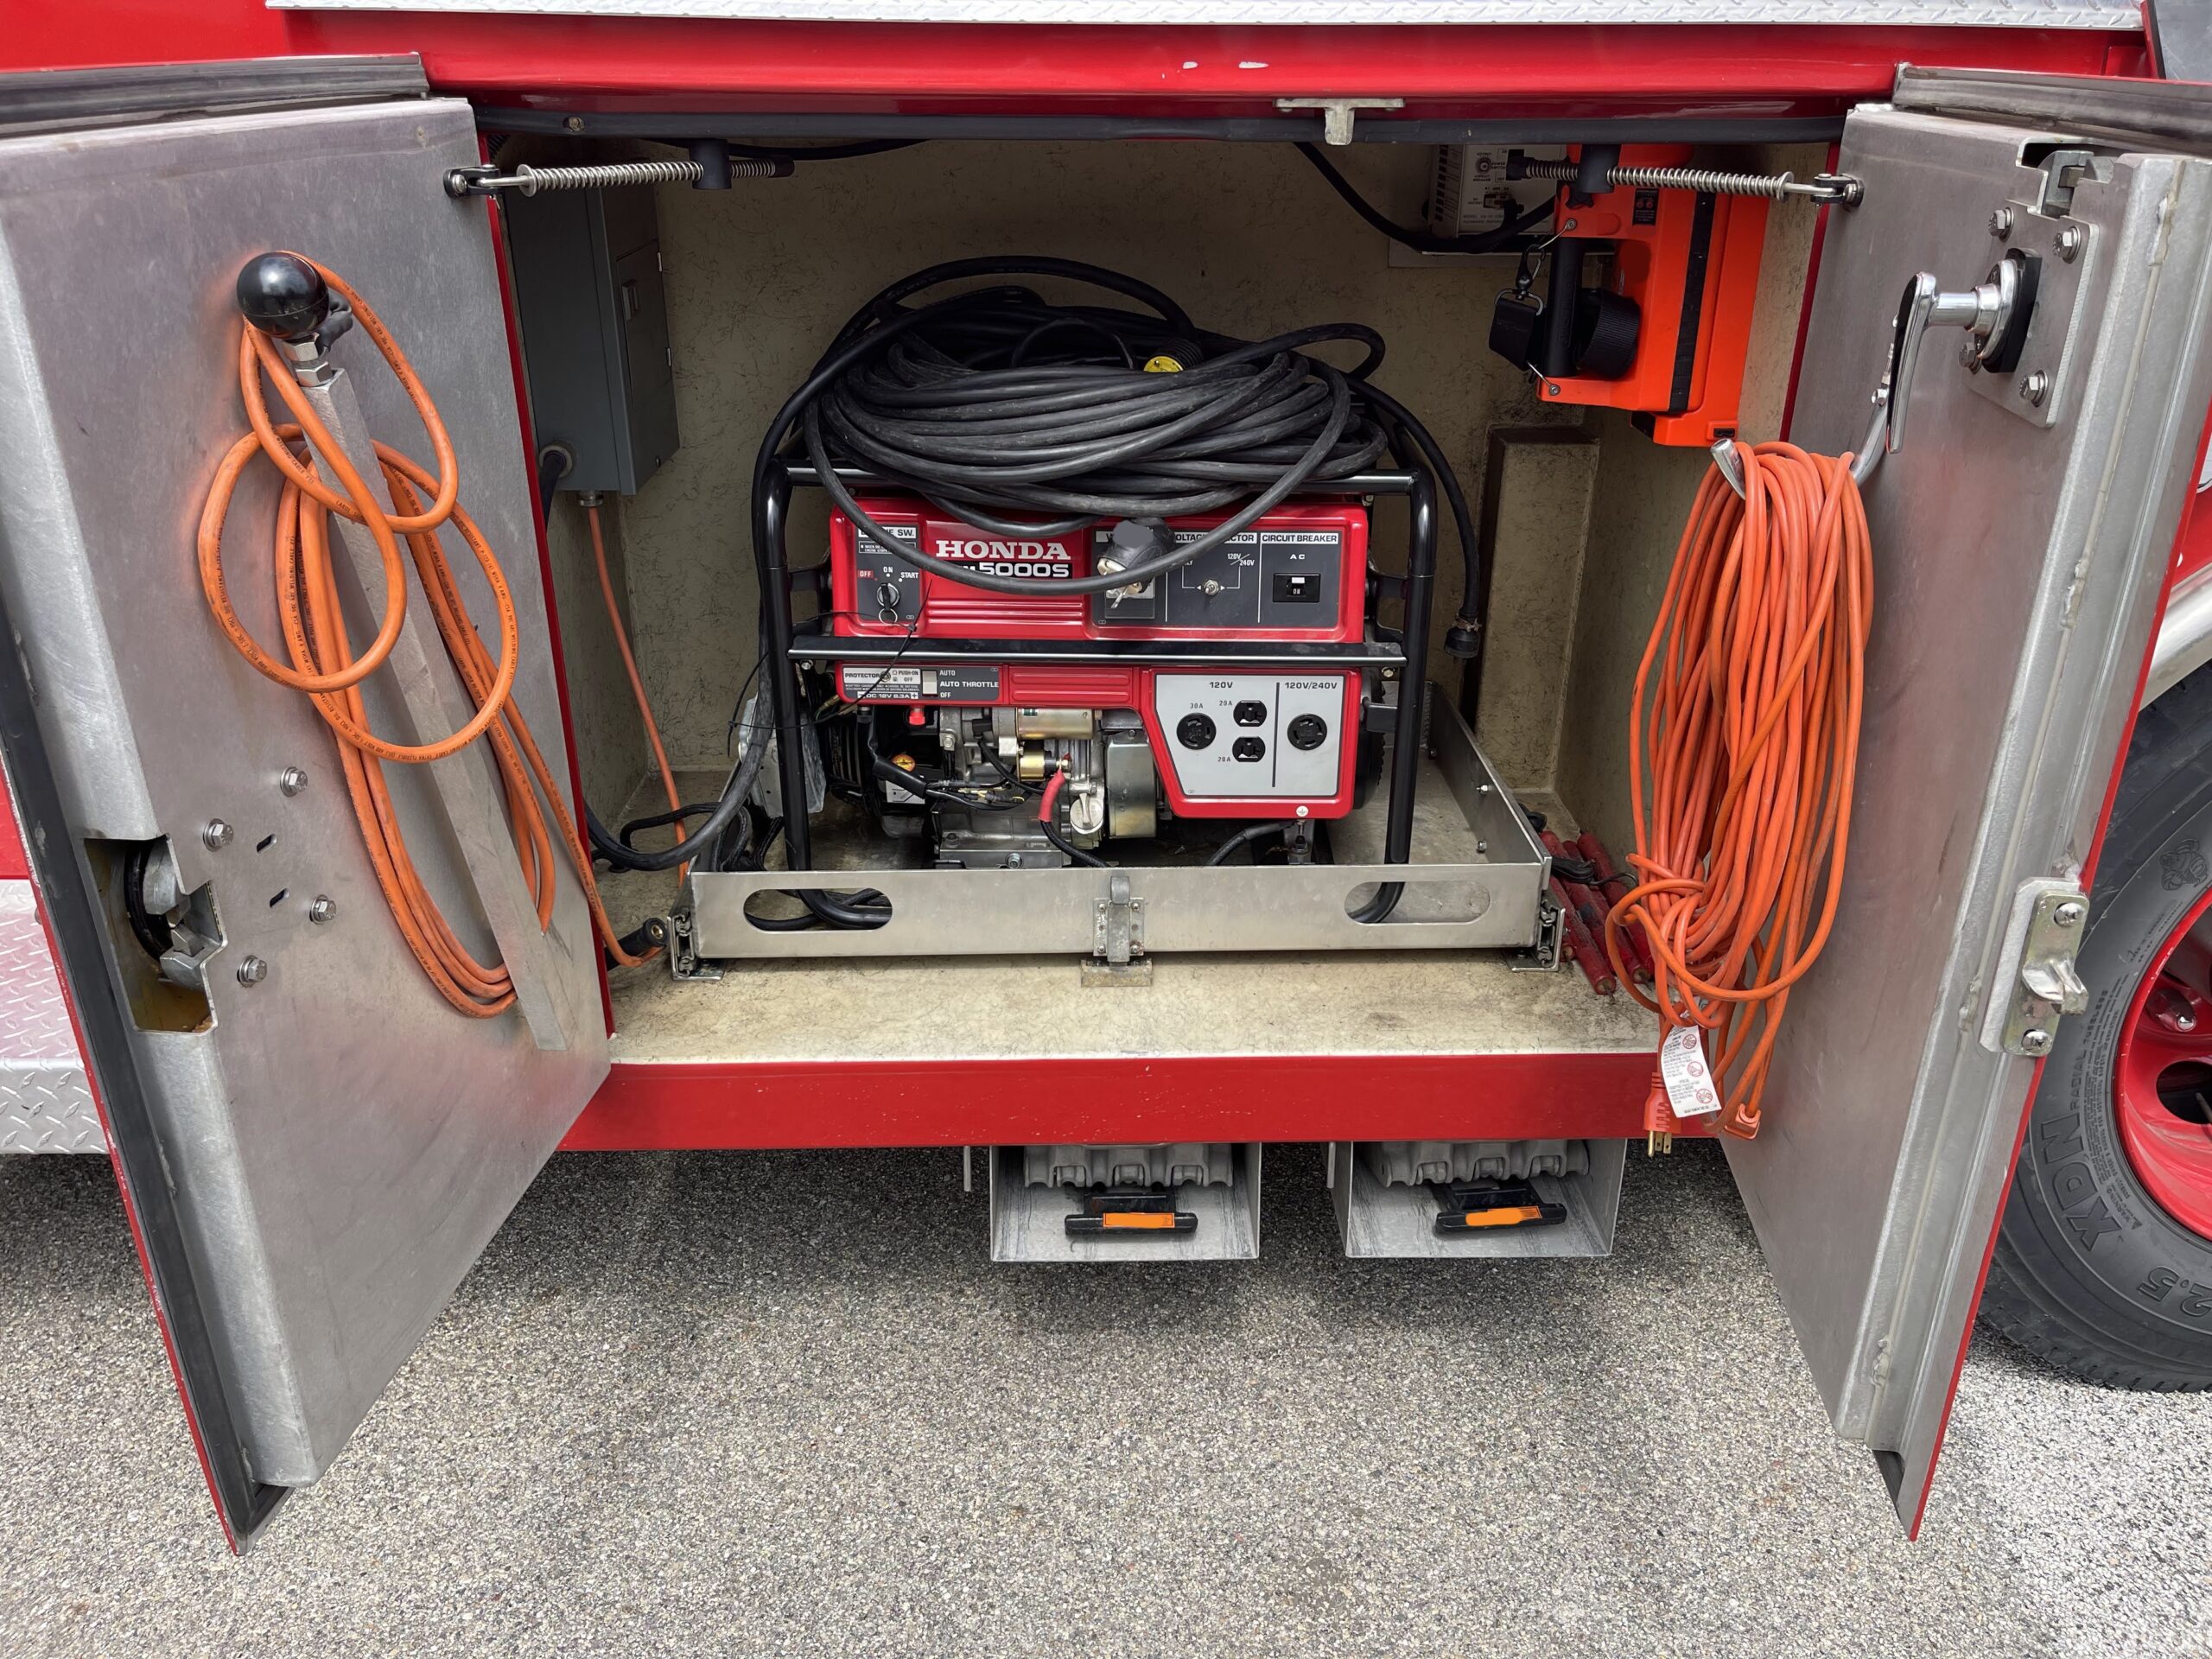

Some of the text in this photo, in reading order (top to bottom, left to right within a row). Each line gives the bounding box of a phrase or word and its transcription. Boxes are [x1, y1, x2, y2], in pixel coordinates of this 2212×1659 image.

[1262, 534, 1338, 543] CIRCUIT BREAKER
[936, 540, 1071, 561] HONDA
[962, 563, 1070, 578] 5000S
[2070, 1050, 2087, 1110] RADIAL
[2041, 1111, 2122, 1252] XDN
